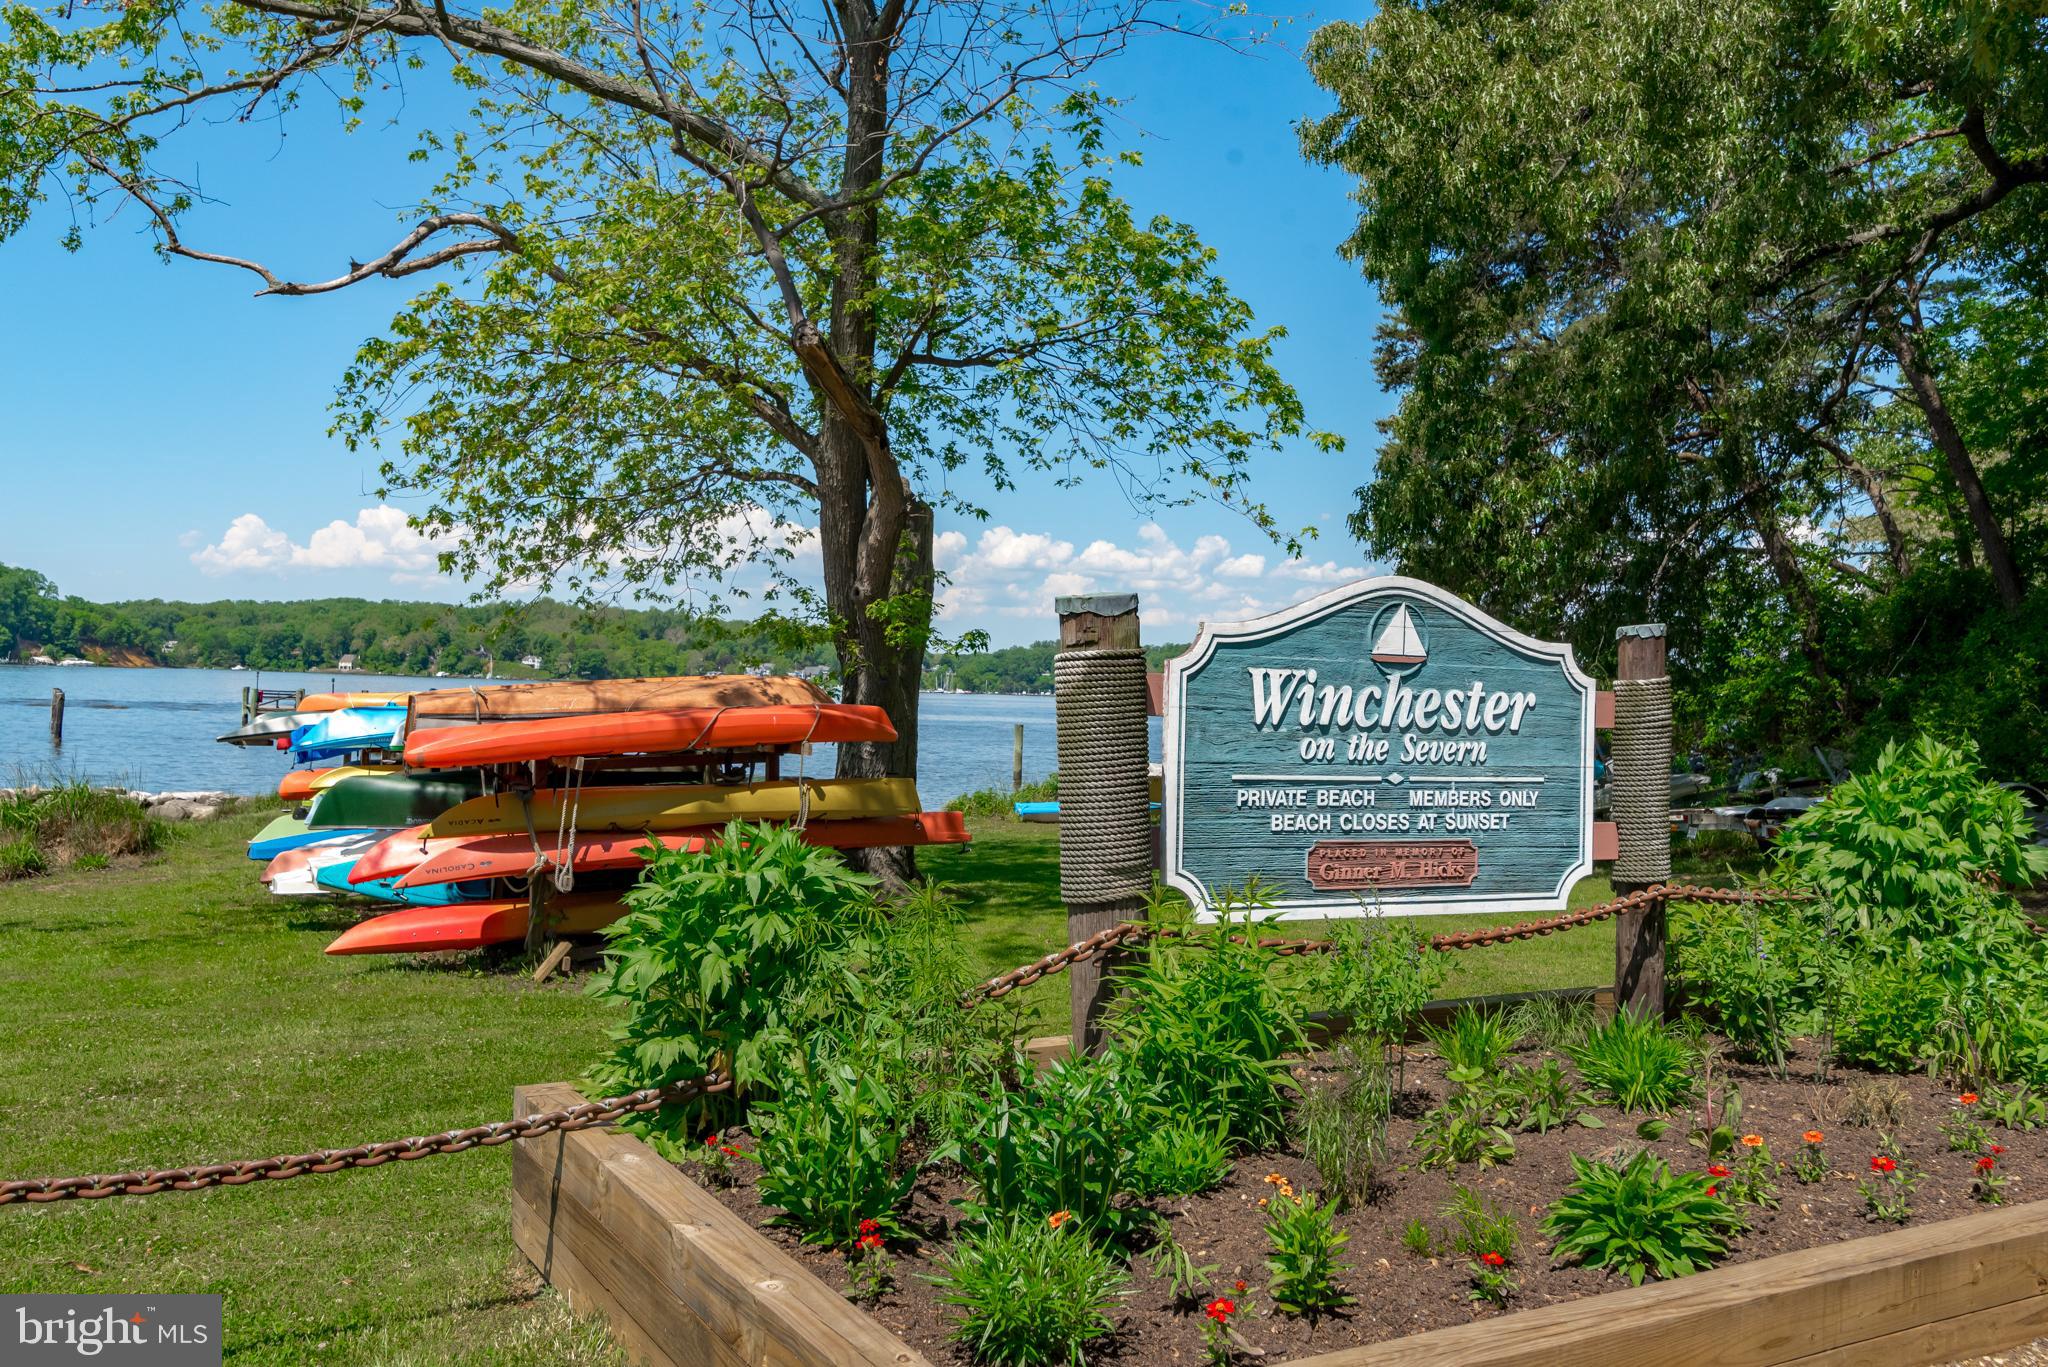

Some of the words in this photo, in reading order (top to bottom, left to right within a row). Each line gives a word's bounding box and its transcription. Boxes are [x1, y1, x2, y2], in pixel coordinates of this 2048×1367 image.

[1247, 666, 1537, 732] Winchester
[1300, 737, 1335, 761] on
[1348, 732, 1389, 762] the
[1400, 733, 1488, 763] Severn
[1237, 789, 1307, 807] PRIVATE
[1317, 789, 1375, 807] BEACH
[1409, 790, 1491, 807] MEMBERS
[1499, 789, 1539, 807] ONLY
[1271, 813, 1331, 831] BEACH
[1340, 813, 1410, 831] CLOSES
[1418, 813, 1437, 830] AT
[1445, 813, 1510, 831] SUNSET
[1319, 848, 1367, 859] PLACED
[1375, 848, 1387, 858] IN
[1395, 847, 1444, 858] MEMORY
[1452, 847, 1466, 856] OF
[425, 863, 476, 874] CAROLINA
[1319, 862, 1382, 881] Ginner
[1390, 861, 1412, 879] M.
[1420, 860, 1465, 878] Hicks
